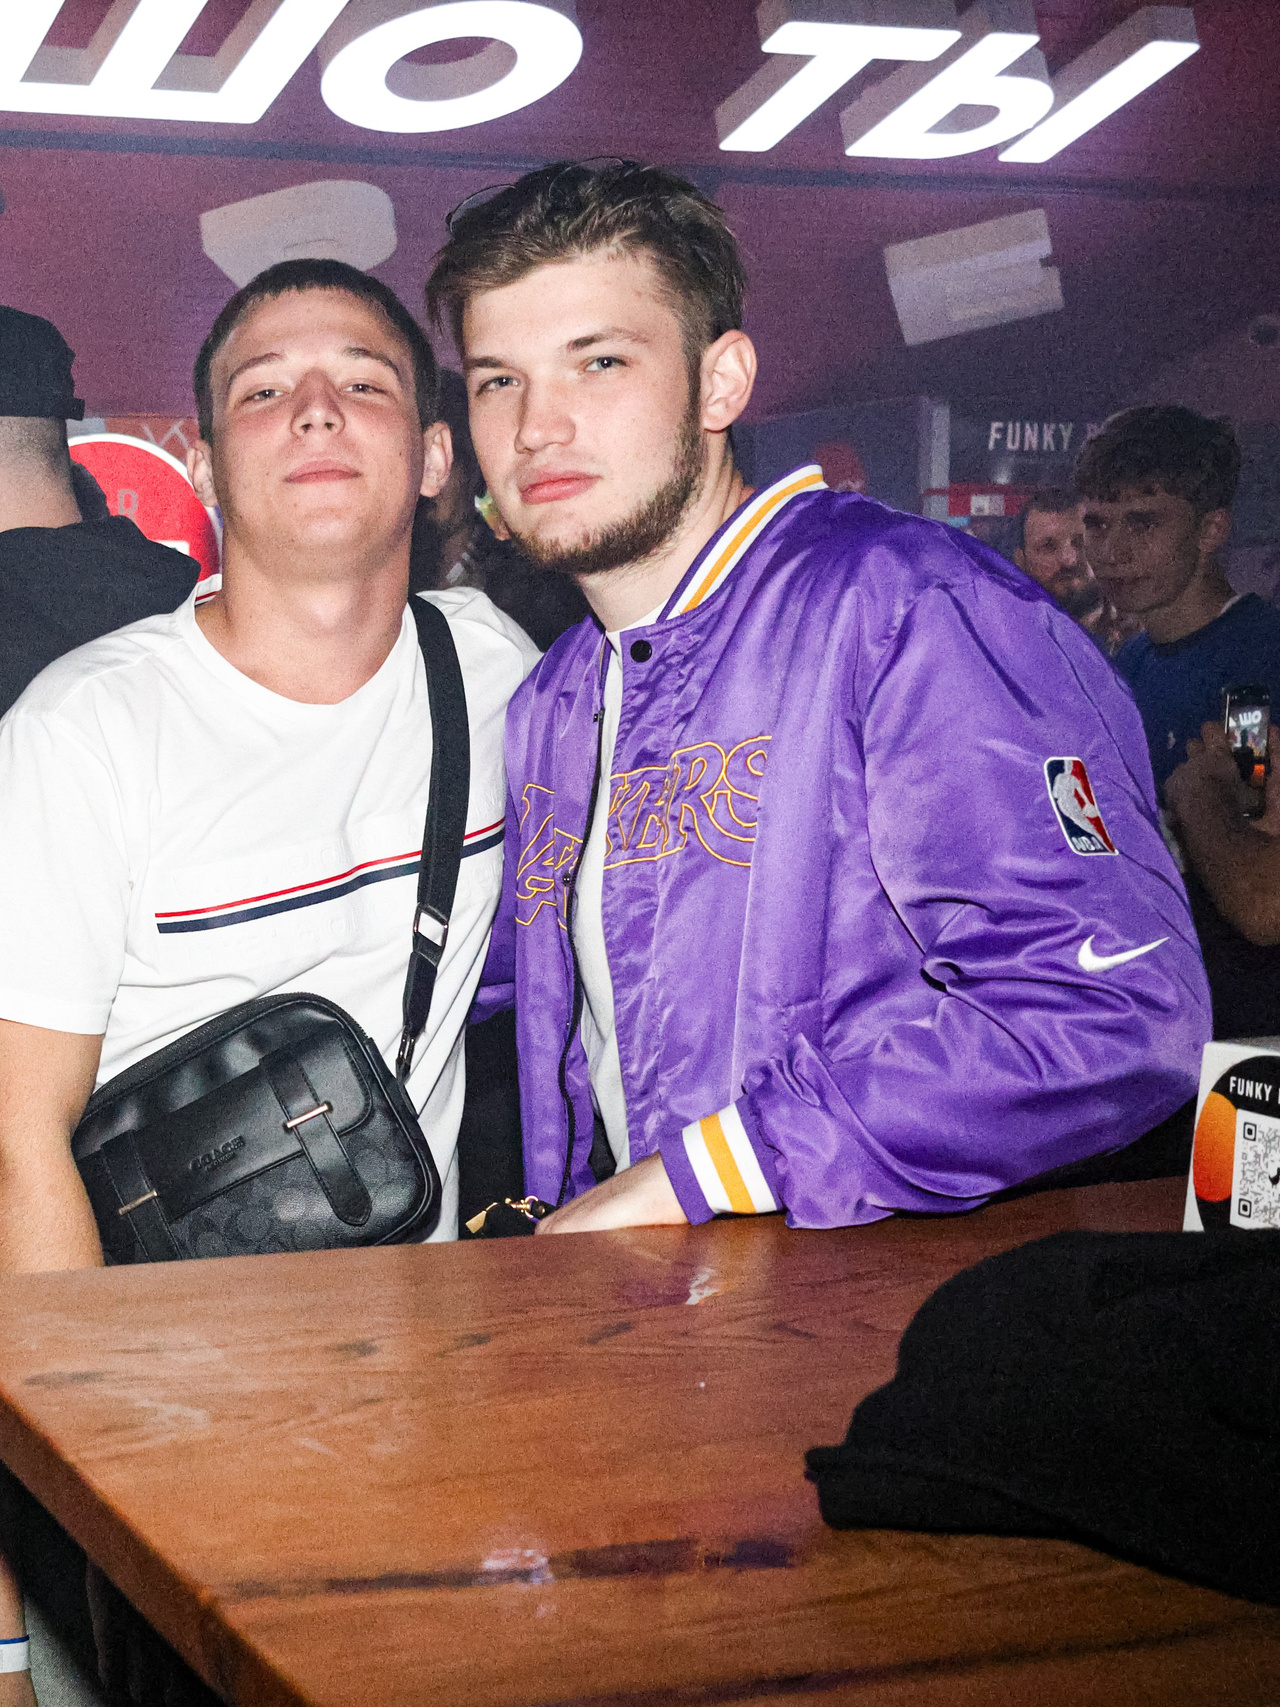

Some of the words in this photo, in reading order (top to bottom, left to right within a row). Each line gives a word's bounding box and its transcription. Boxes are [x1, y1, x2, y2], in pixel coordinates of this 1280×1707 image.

[719, 21, 1201, 163] ТЫ
[988, 421, 1072, 451] FUNKY
[1229, 1076, 1272, 1102] FUNKY
